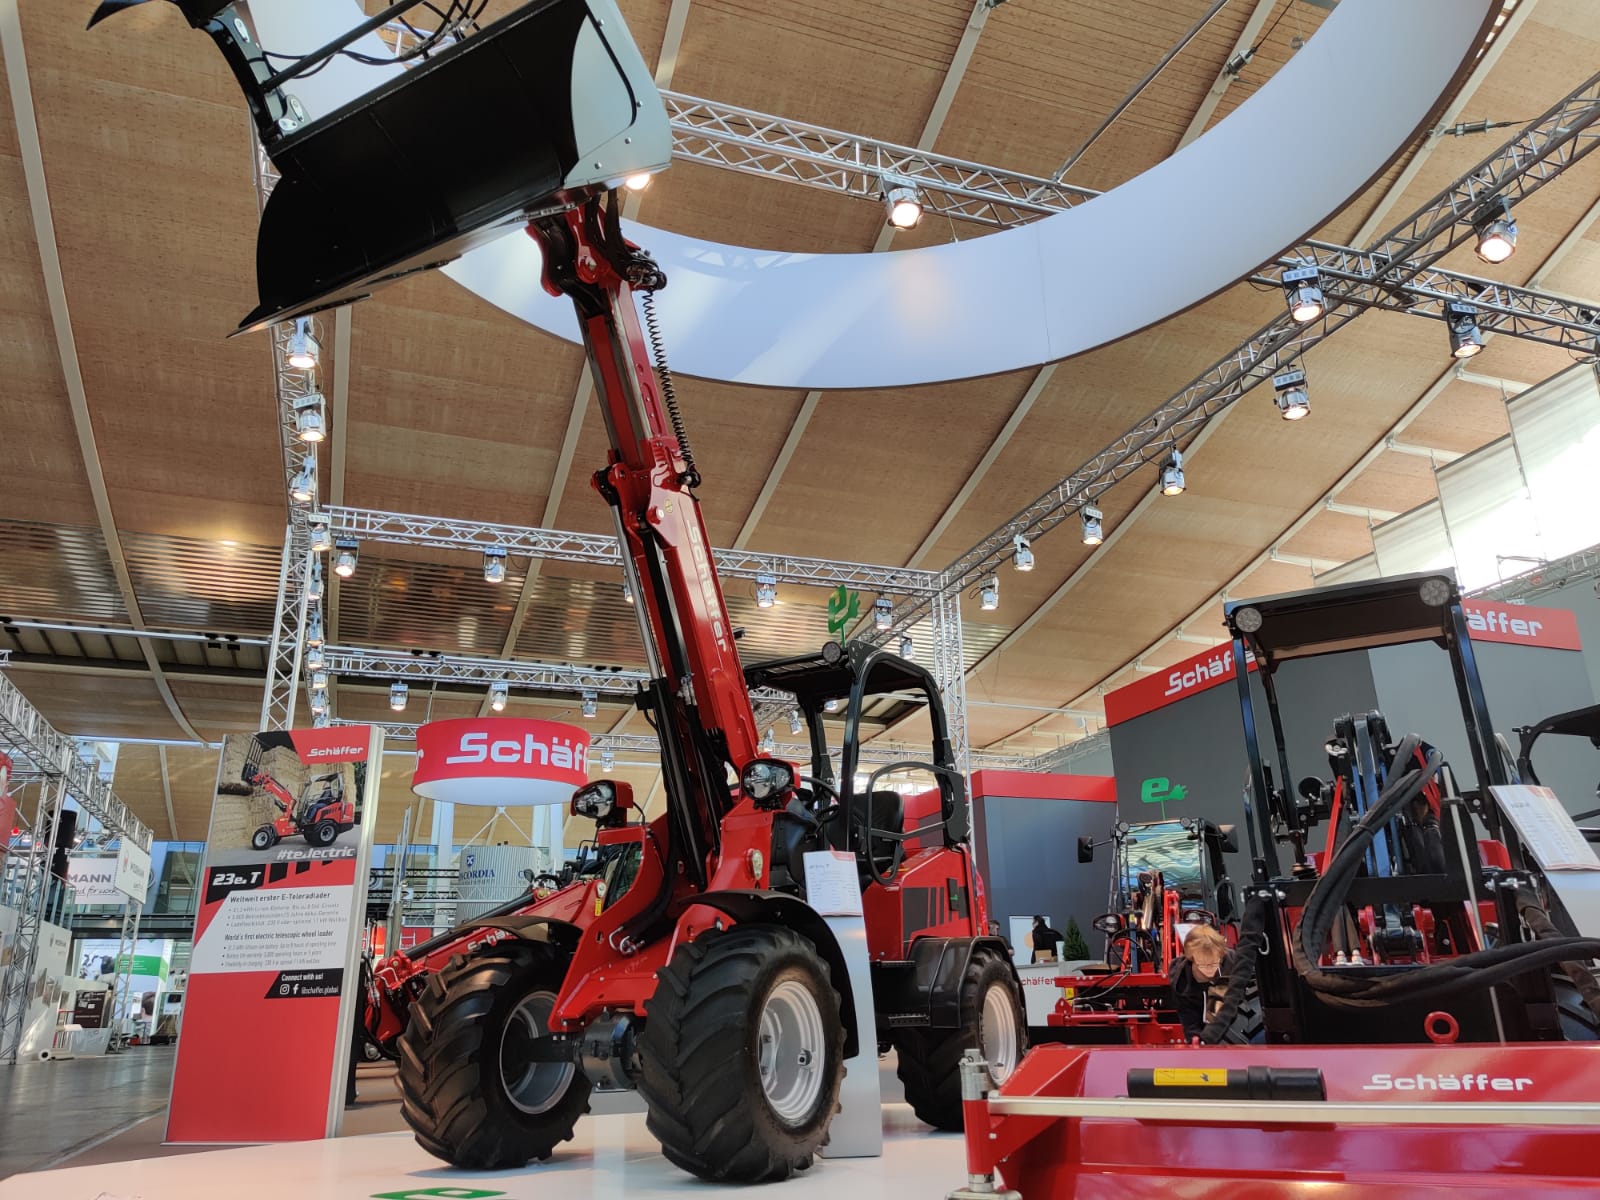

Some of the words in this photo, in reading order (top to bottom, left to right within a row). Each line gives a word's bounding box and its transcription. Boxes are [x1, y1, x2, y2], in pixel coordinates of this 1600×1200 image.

[686, 519, 728, 653] Schäffer
[307, 746, 364, 757] Schäffer
[281, 892, 331, 901] E-Teleradlader
[255, 932, 274, 940] electric
[275, 930, 301, 939] telescopic
[301, 930, 316, 938] wheel
[317, 929, 333, 937] loader
[1020, 976, 1055, 986] chäffer
[1363, 1074, 1533, 1091] Schäffer
